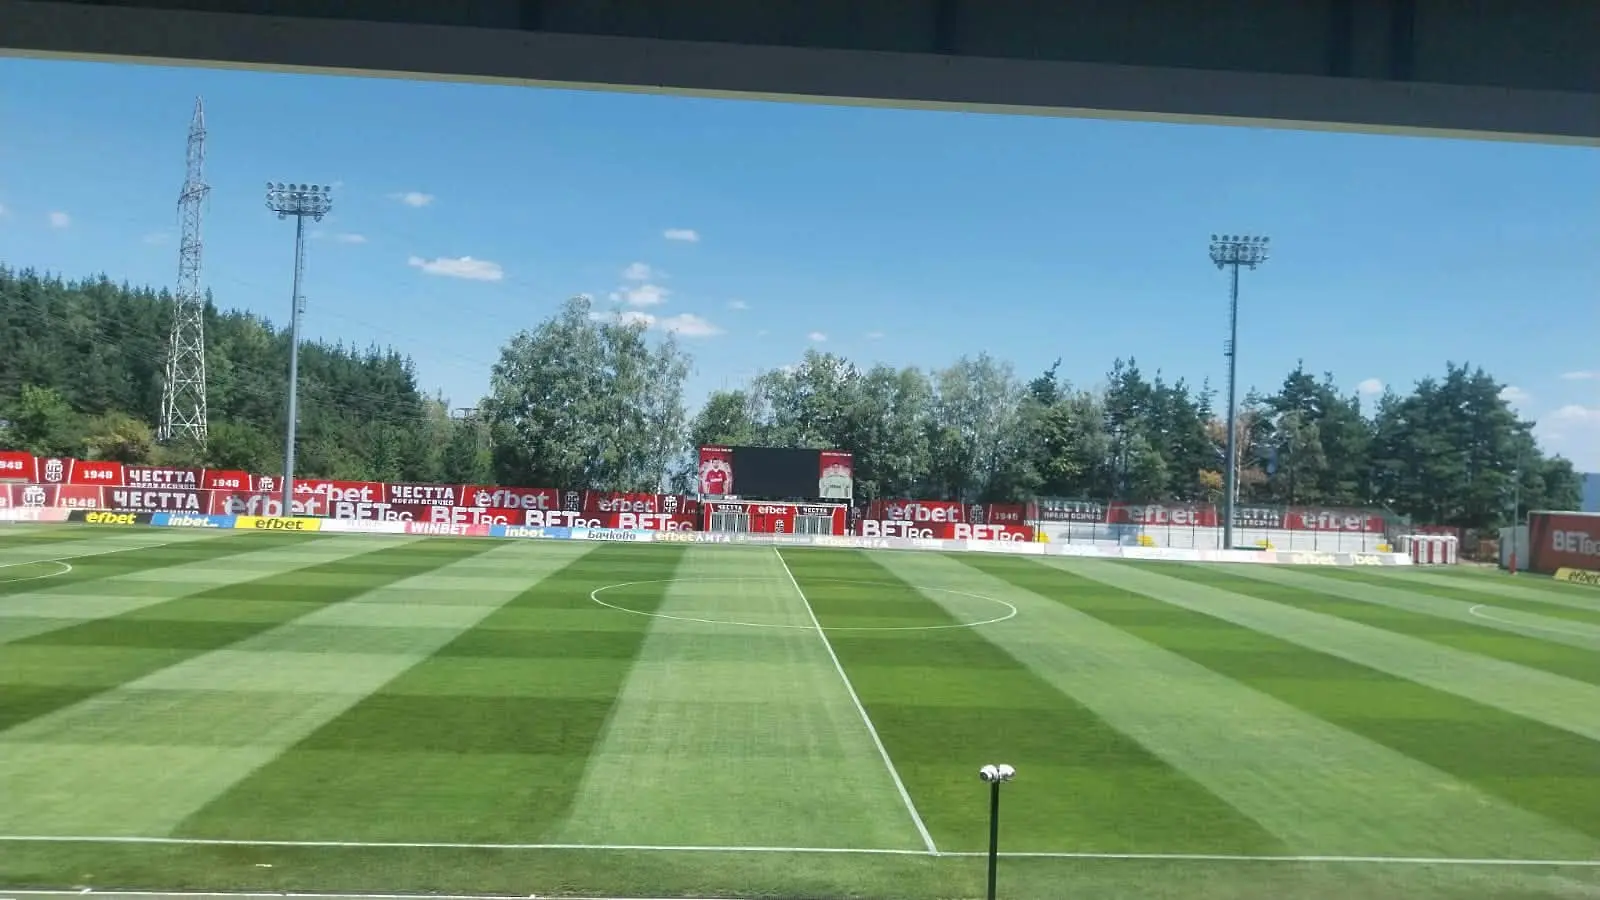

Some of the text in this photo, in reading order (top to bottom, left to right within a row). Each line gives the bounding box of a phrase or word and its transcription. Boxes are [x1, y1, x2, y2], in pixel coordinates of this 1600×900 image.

[83, 470, 113, 479] 1948
[129, 470, 196, 482] ЧЕСТТА
[212, 479, 240, 488] 1948
[391, 486, 455, 499] ЧЕСТТА
[60, 497, 97, 508] 1948
[113, 491, 200, 509] ЧЕСТТА
[222, 495, 321, 516] efbet
[473, 490, 550, 510] efbet
[758, 506, 788, 514] efbet
[886, 504, 959, 522] efbet
[87, 512, 137, 525] efbet
[255, 518, 305, 530] efbet
[410, 523, 469, 536] WINBET
